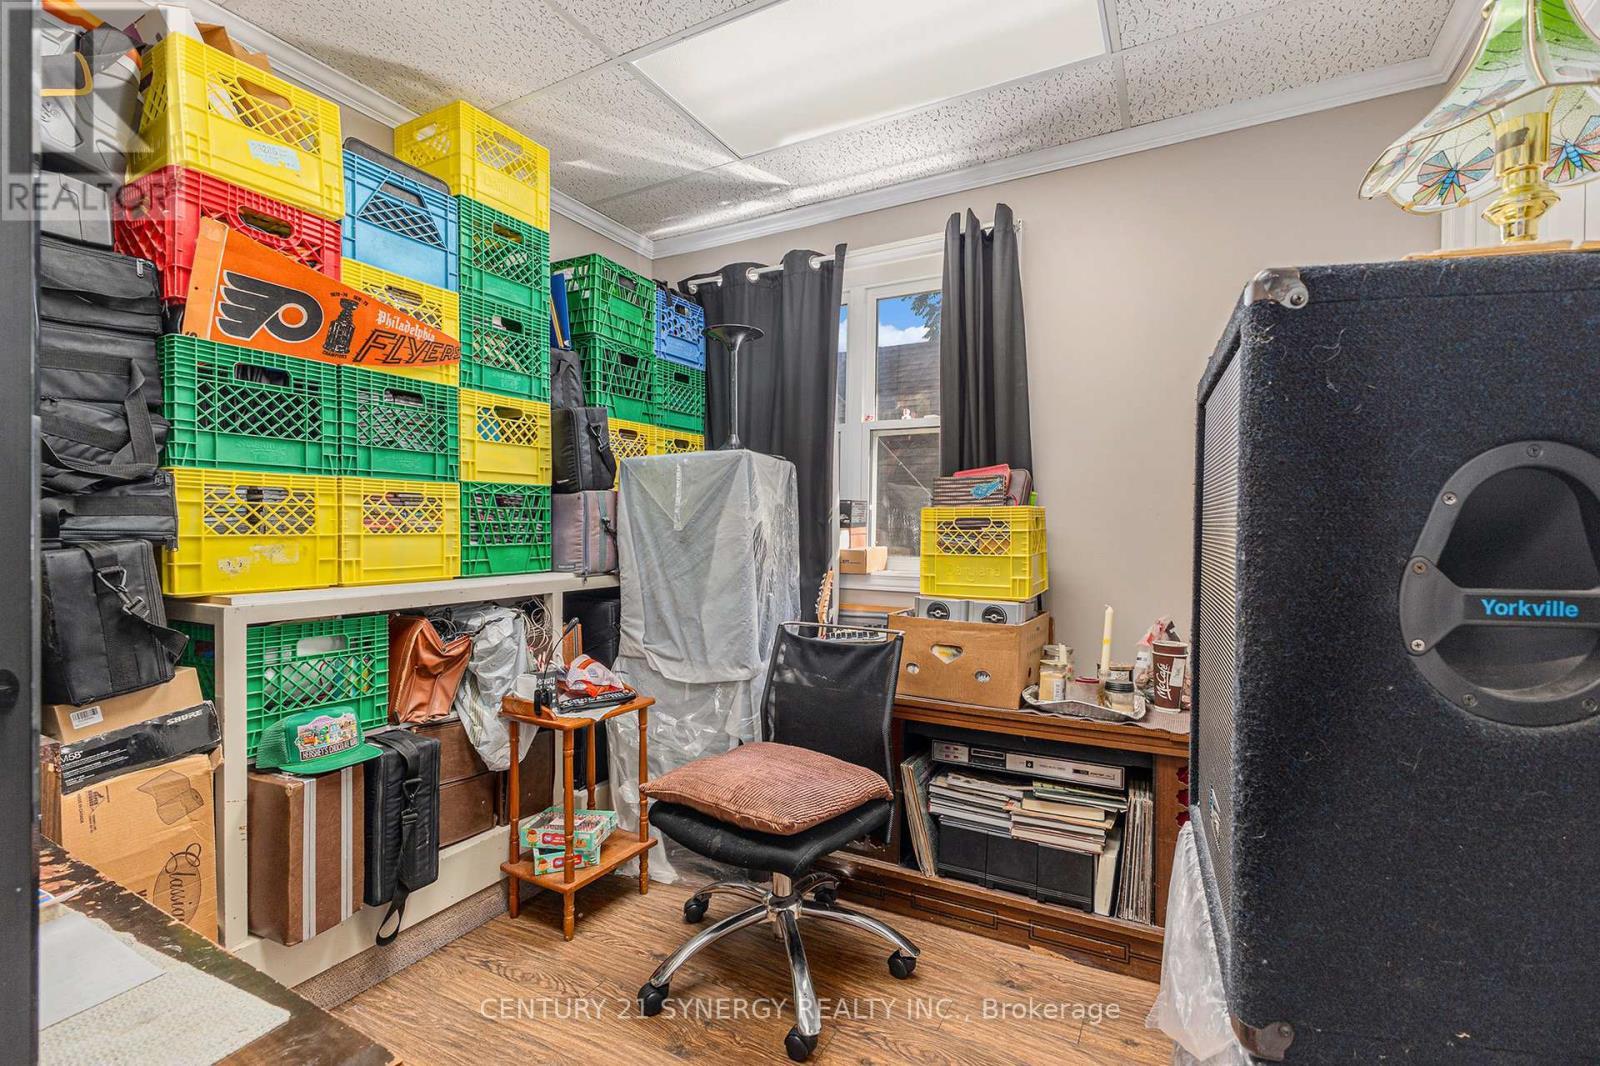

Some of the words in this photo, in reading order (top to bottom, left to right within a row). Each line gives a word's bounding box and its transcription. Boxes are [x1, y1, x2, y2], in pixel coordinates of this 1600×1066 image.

[376, 309, 435, 342] Philadelphia
[352, 328, 461, 365] FLYERS
[1481, 598, 1579, 618] Yorkville
[1155, 662, 1172, 701] McCafé
[166, 708, 203, 726] SHURE
